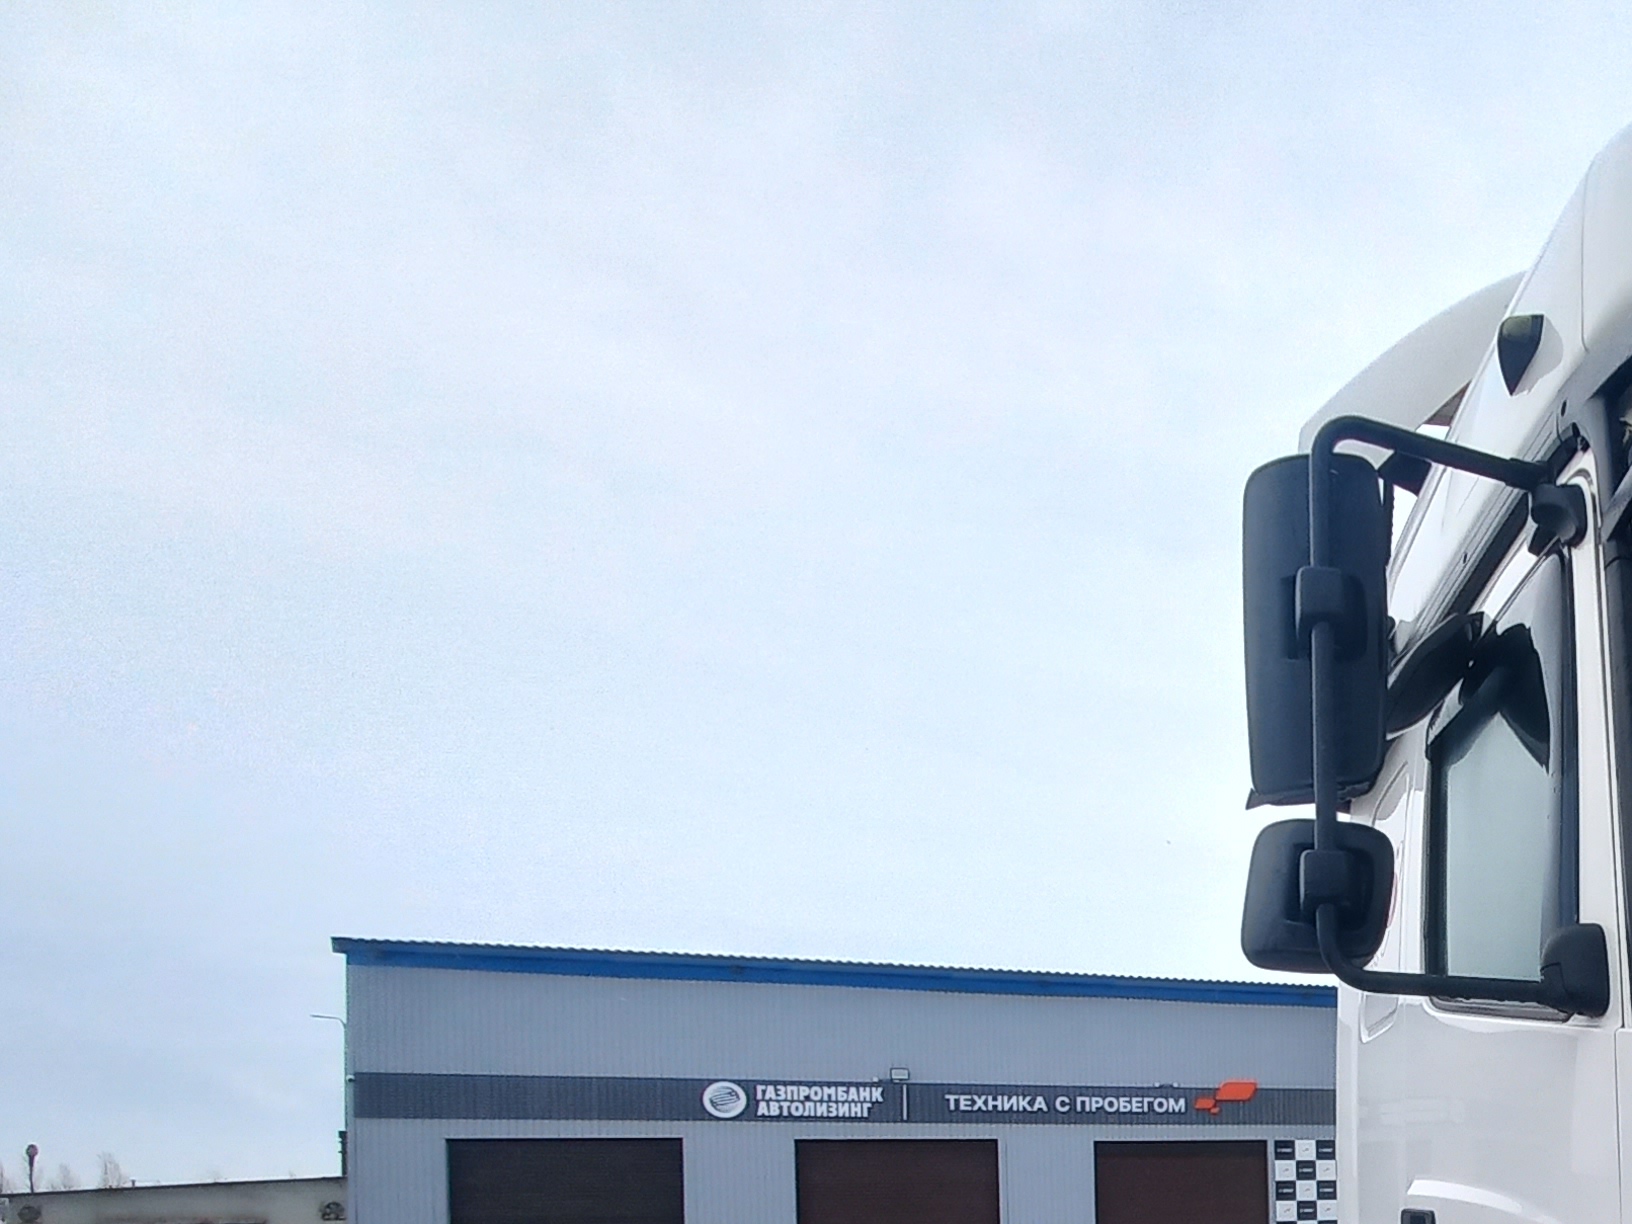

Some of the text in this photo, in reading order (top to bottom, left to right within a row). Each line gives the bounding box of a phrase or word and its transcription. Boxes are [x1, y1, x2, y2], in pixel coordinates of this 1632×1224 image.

[755, 1084, 884, 1102] ГАЗПРОМБАНК
[757, 1102, 874, 1118] АВТОЛИЗИНГ
[944, 1094, 1186, 1114] ТЕХНИКА С ПРОБЕГОМ
